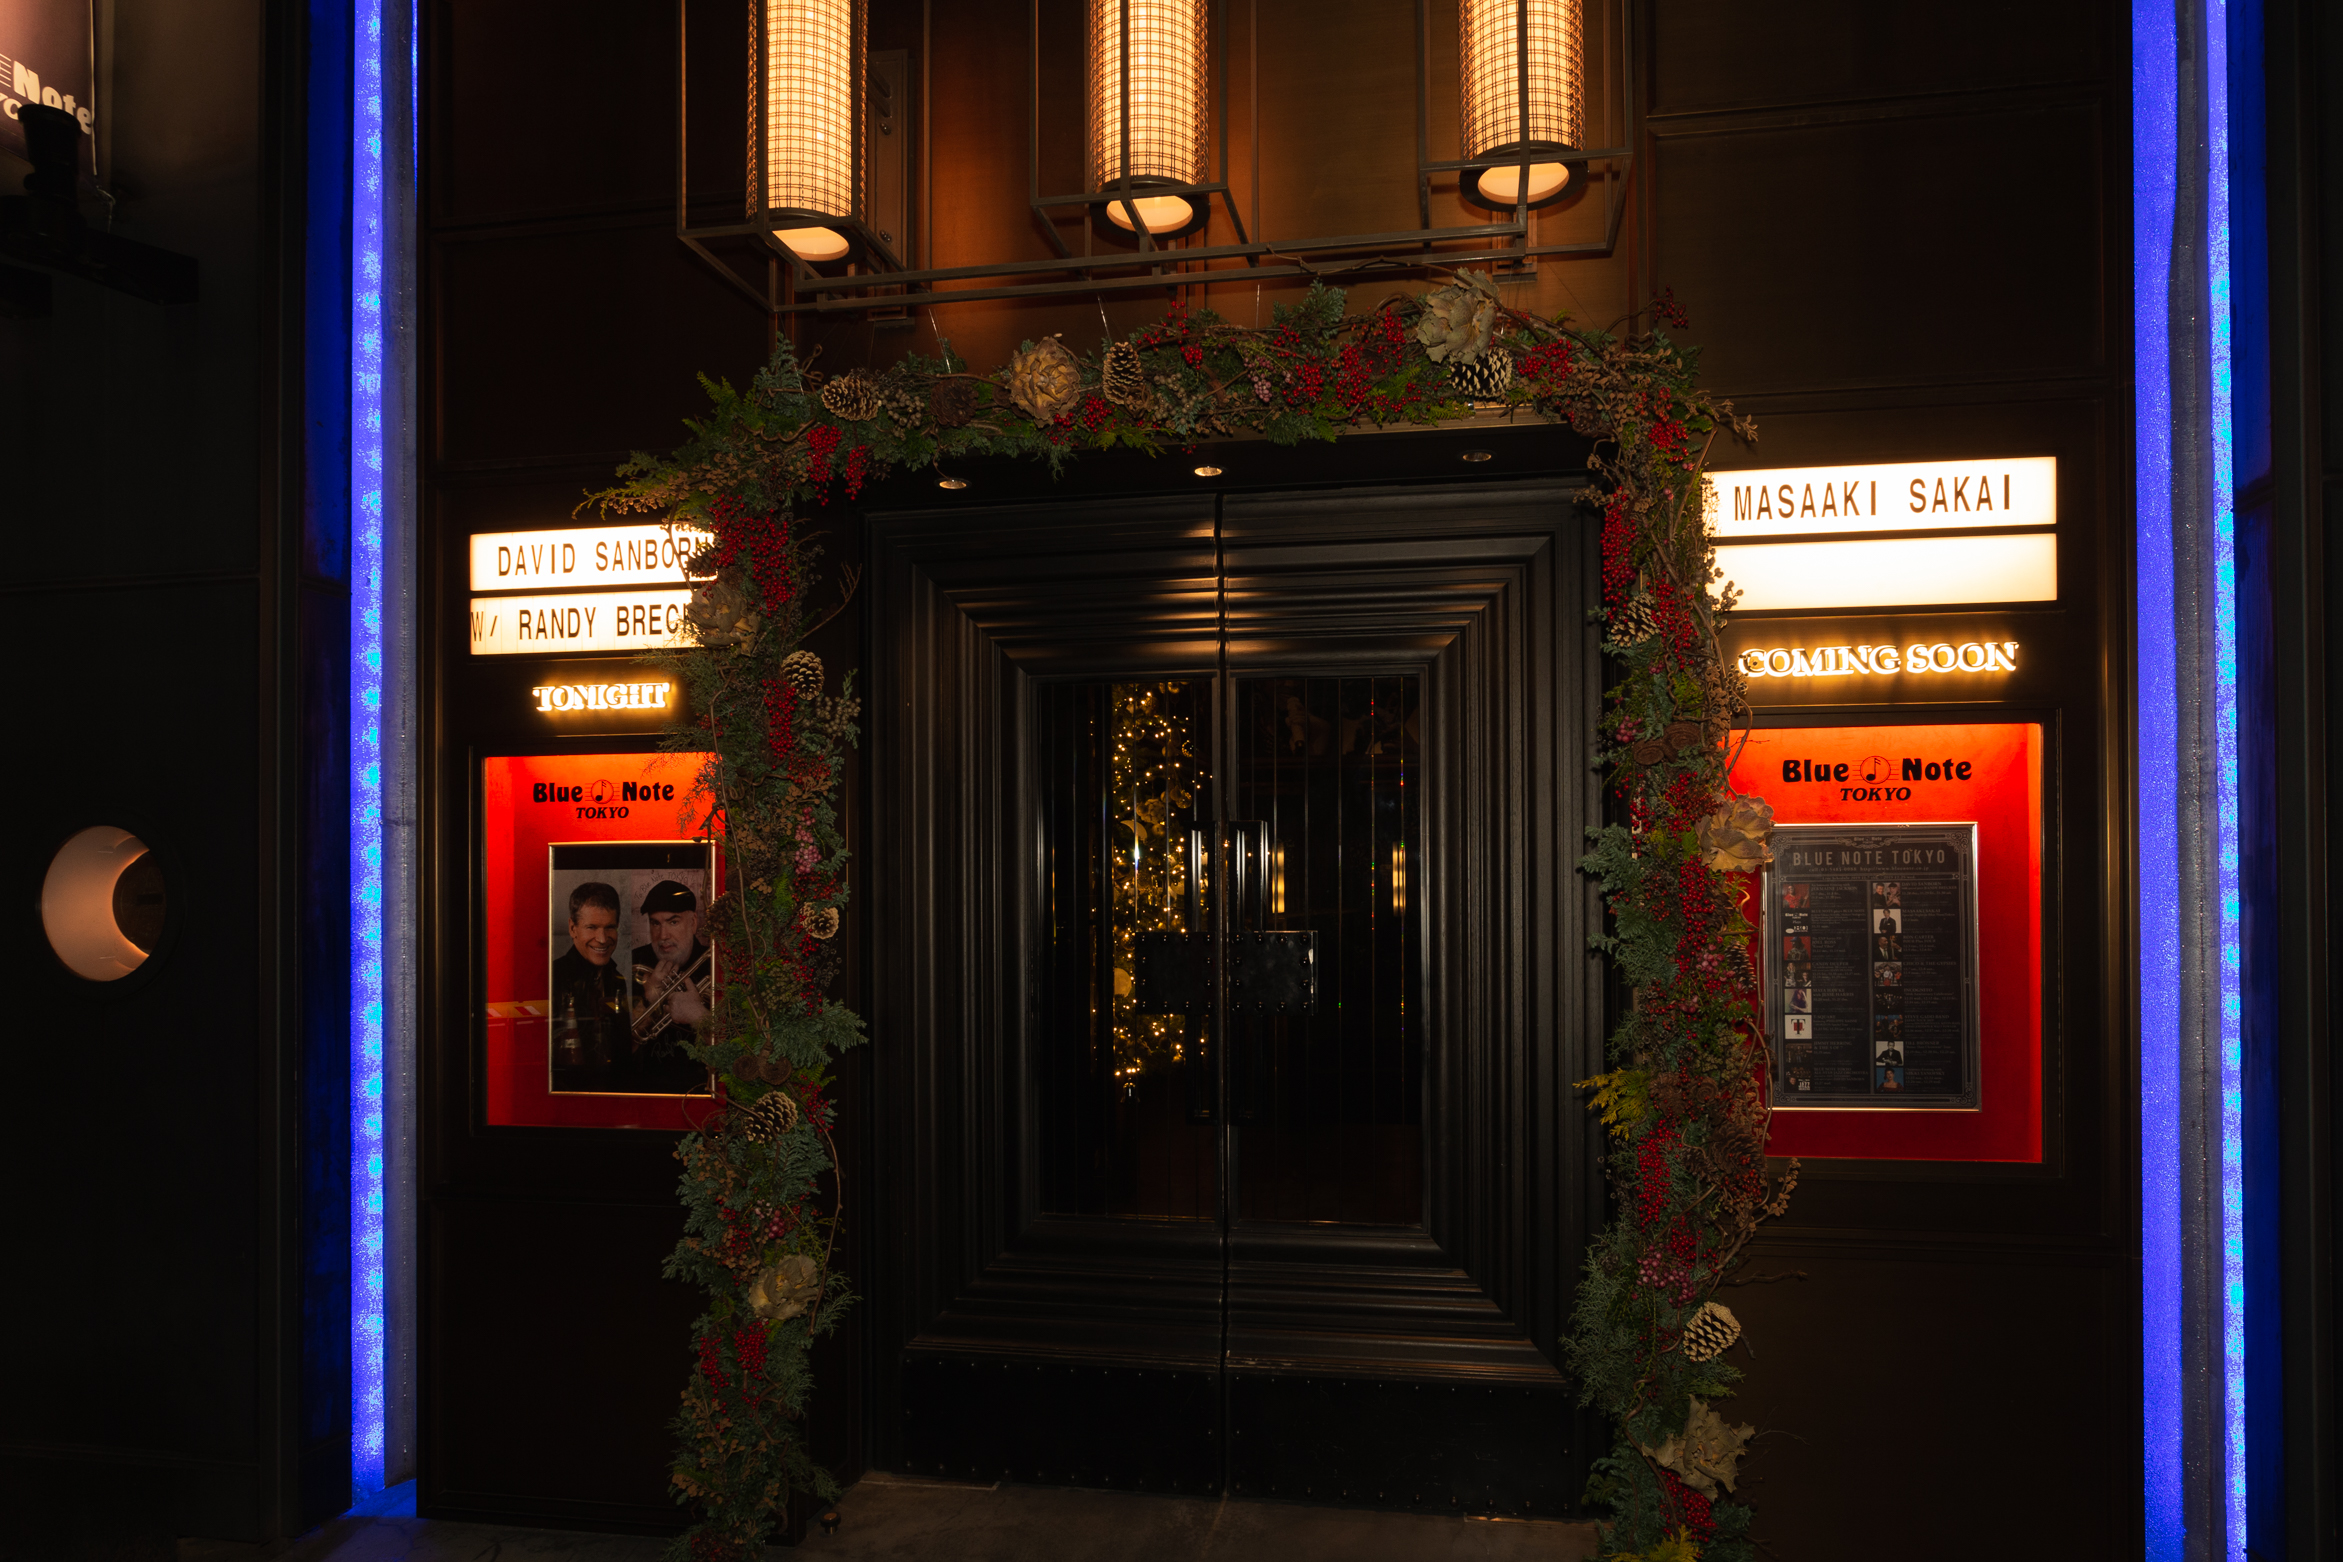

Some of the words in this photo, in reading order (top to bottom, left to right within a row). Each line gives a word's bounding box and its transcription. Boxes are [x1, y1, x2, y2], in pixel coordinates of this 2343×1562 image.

[13, 60, 91, 134] Note
[1734, 480, 1876, 521] MASAAKI
[1909, 474, 2010, 513] SAKAI
[498, 543, 575, 577] DAVID
[519, 607, 596, 640] RANDY
[1738, 645, 1901, 677] COMING
[1906, 641, 2019, 673] SOON
[533, 682, 670, 711] TONIGHT
[1782, 759, 1849, 782] Blue
[1902, 757, 1972, 781] Note
[533, 783, 583, 803] Blue
[622, 781, 674, 801] Note
[1840, 787, 1911, 801] TOKYO
[576, 806, 629, 819] TOKYO
[1793, 851, 1833, 866] BLUE
[1841, 850, 1883, 865] NOTE
[1892, 849, 1945, 864] TOKYO
